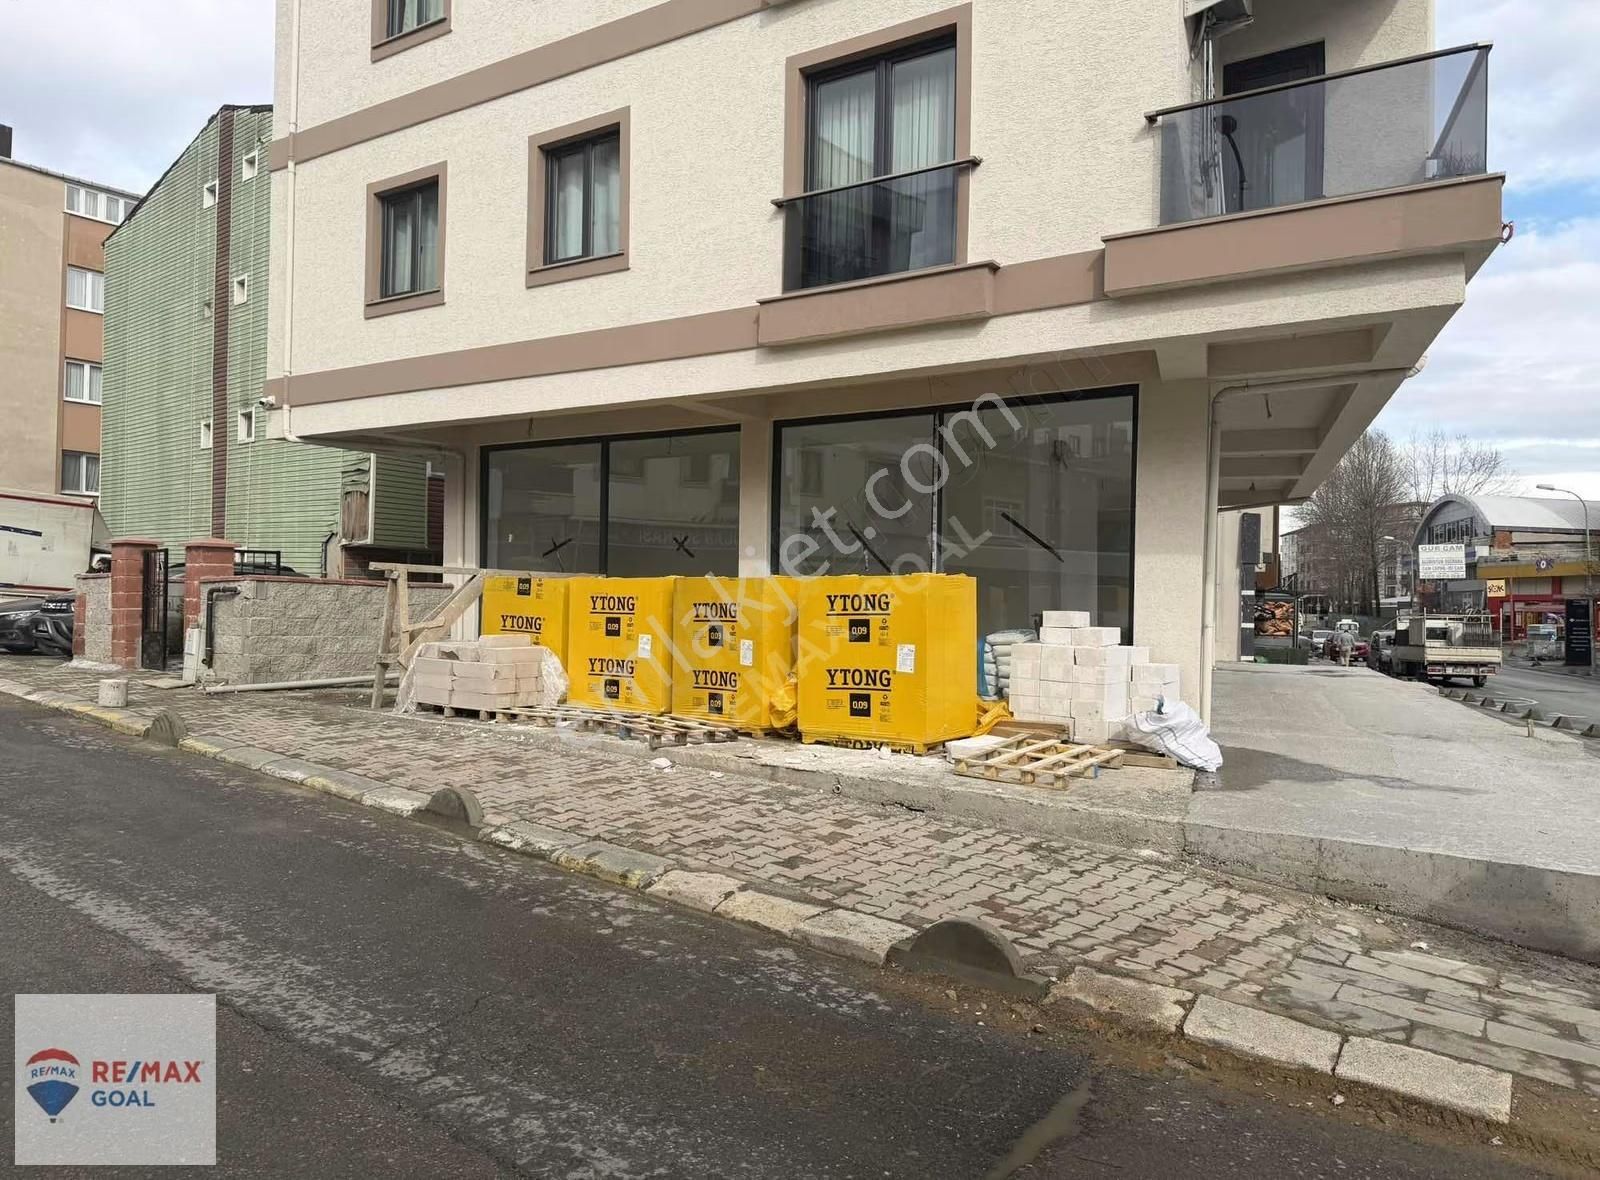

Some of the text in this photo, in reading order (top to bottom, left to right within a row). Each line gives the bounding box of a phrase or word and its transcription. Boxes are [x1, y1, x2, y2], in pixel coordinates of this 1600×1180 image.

[590, 595, 635, 611] YTONG
[693, 602, 737, 618] YTONG
[826, 593, 890, 612] YTONG
[501, 614, 542, 631] YTONG
[588, 657, 635, 675] YTONG
[693, 669, 737, 689] YTONG
[826, 668, 892, 688] YTONG
